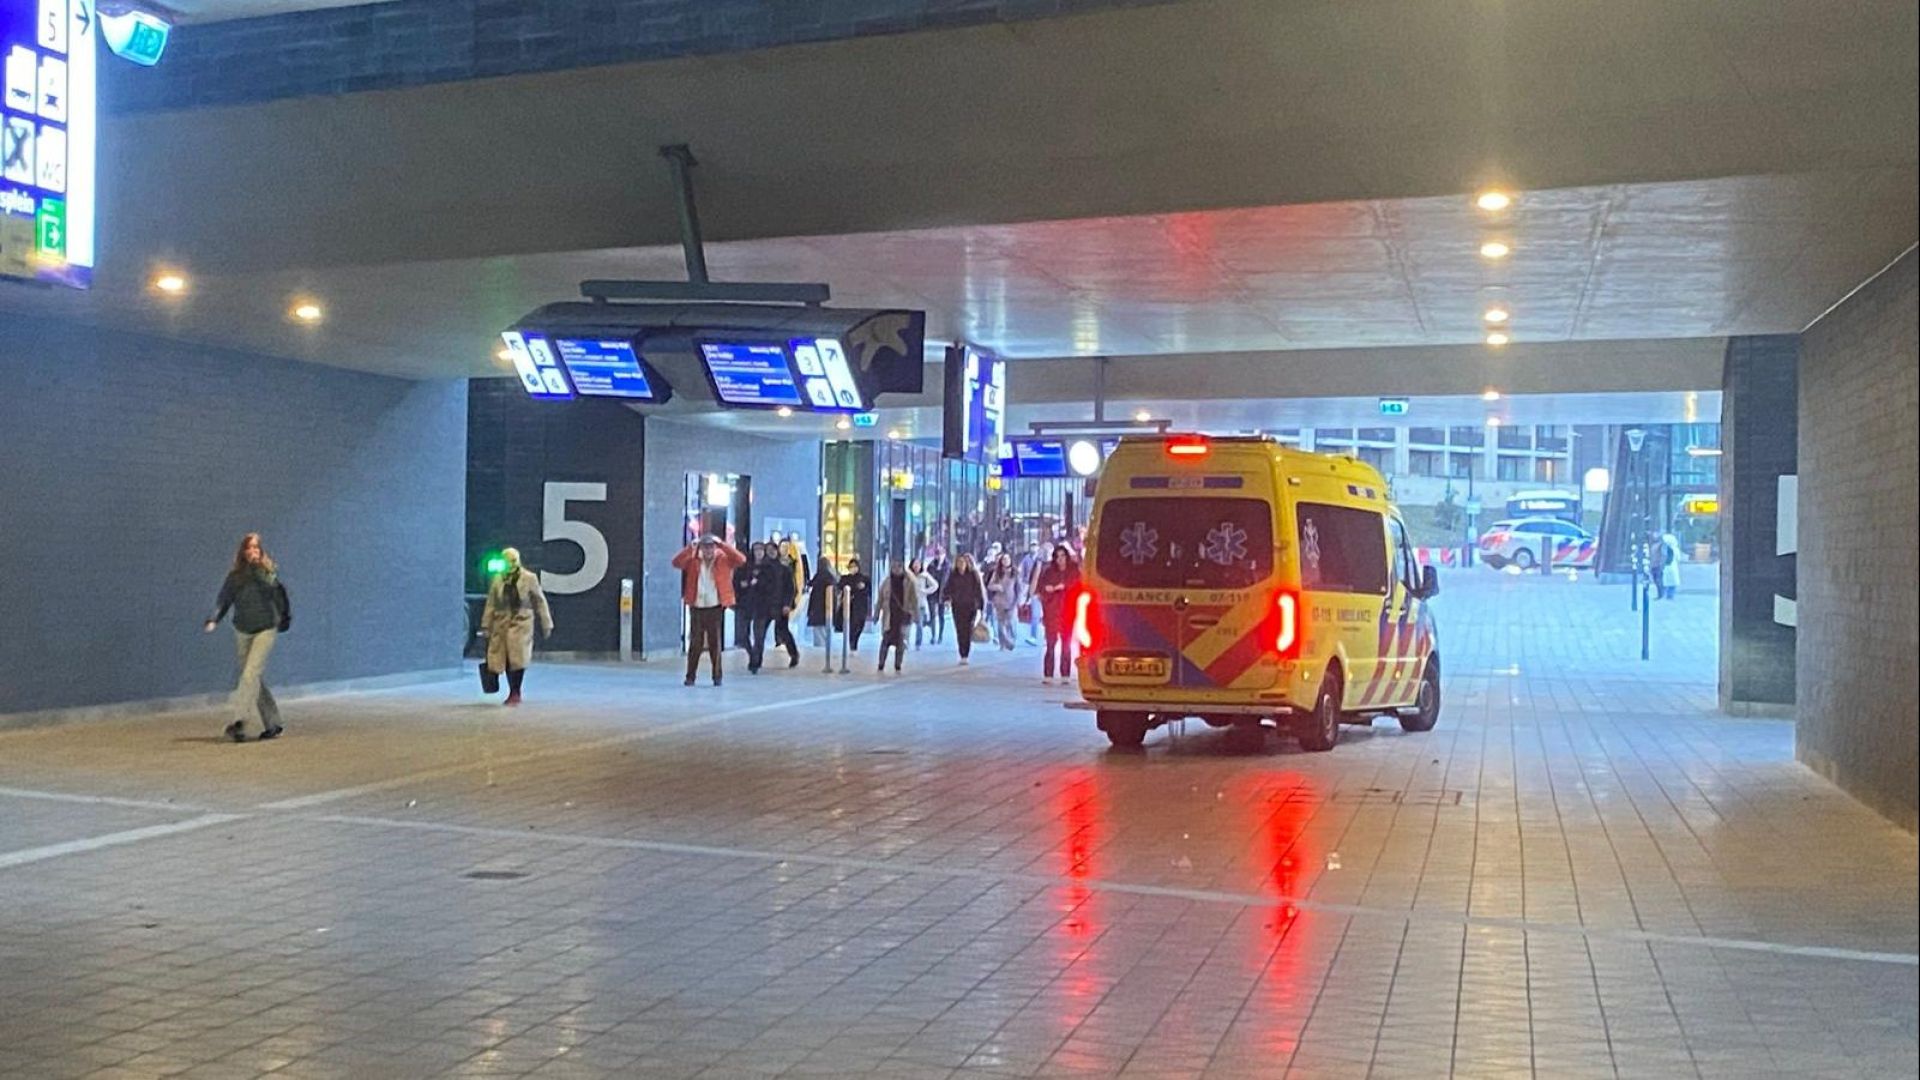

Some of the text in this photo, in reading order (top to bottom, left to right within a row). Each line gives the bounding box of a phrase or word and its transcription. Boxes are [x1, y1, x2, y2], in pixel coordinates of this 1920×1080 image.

[48, 11, 57, 42] 5
[536, 348, 547, 363] 3
[540, 481, 609, 594] 5
